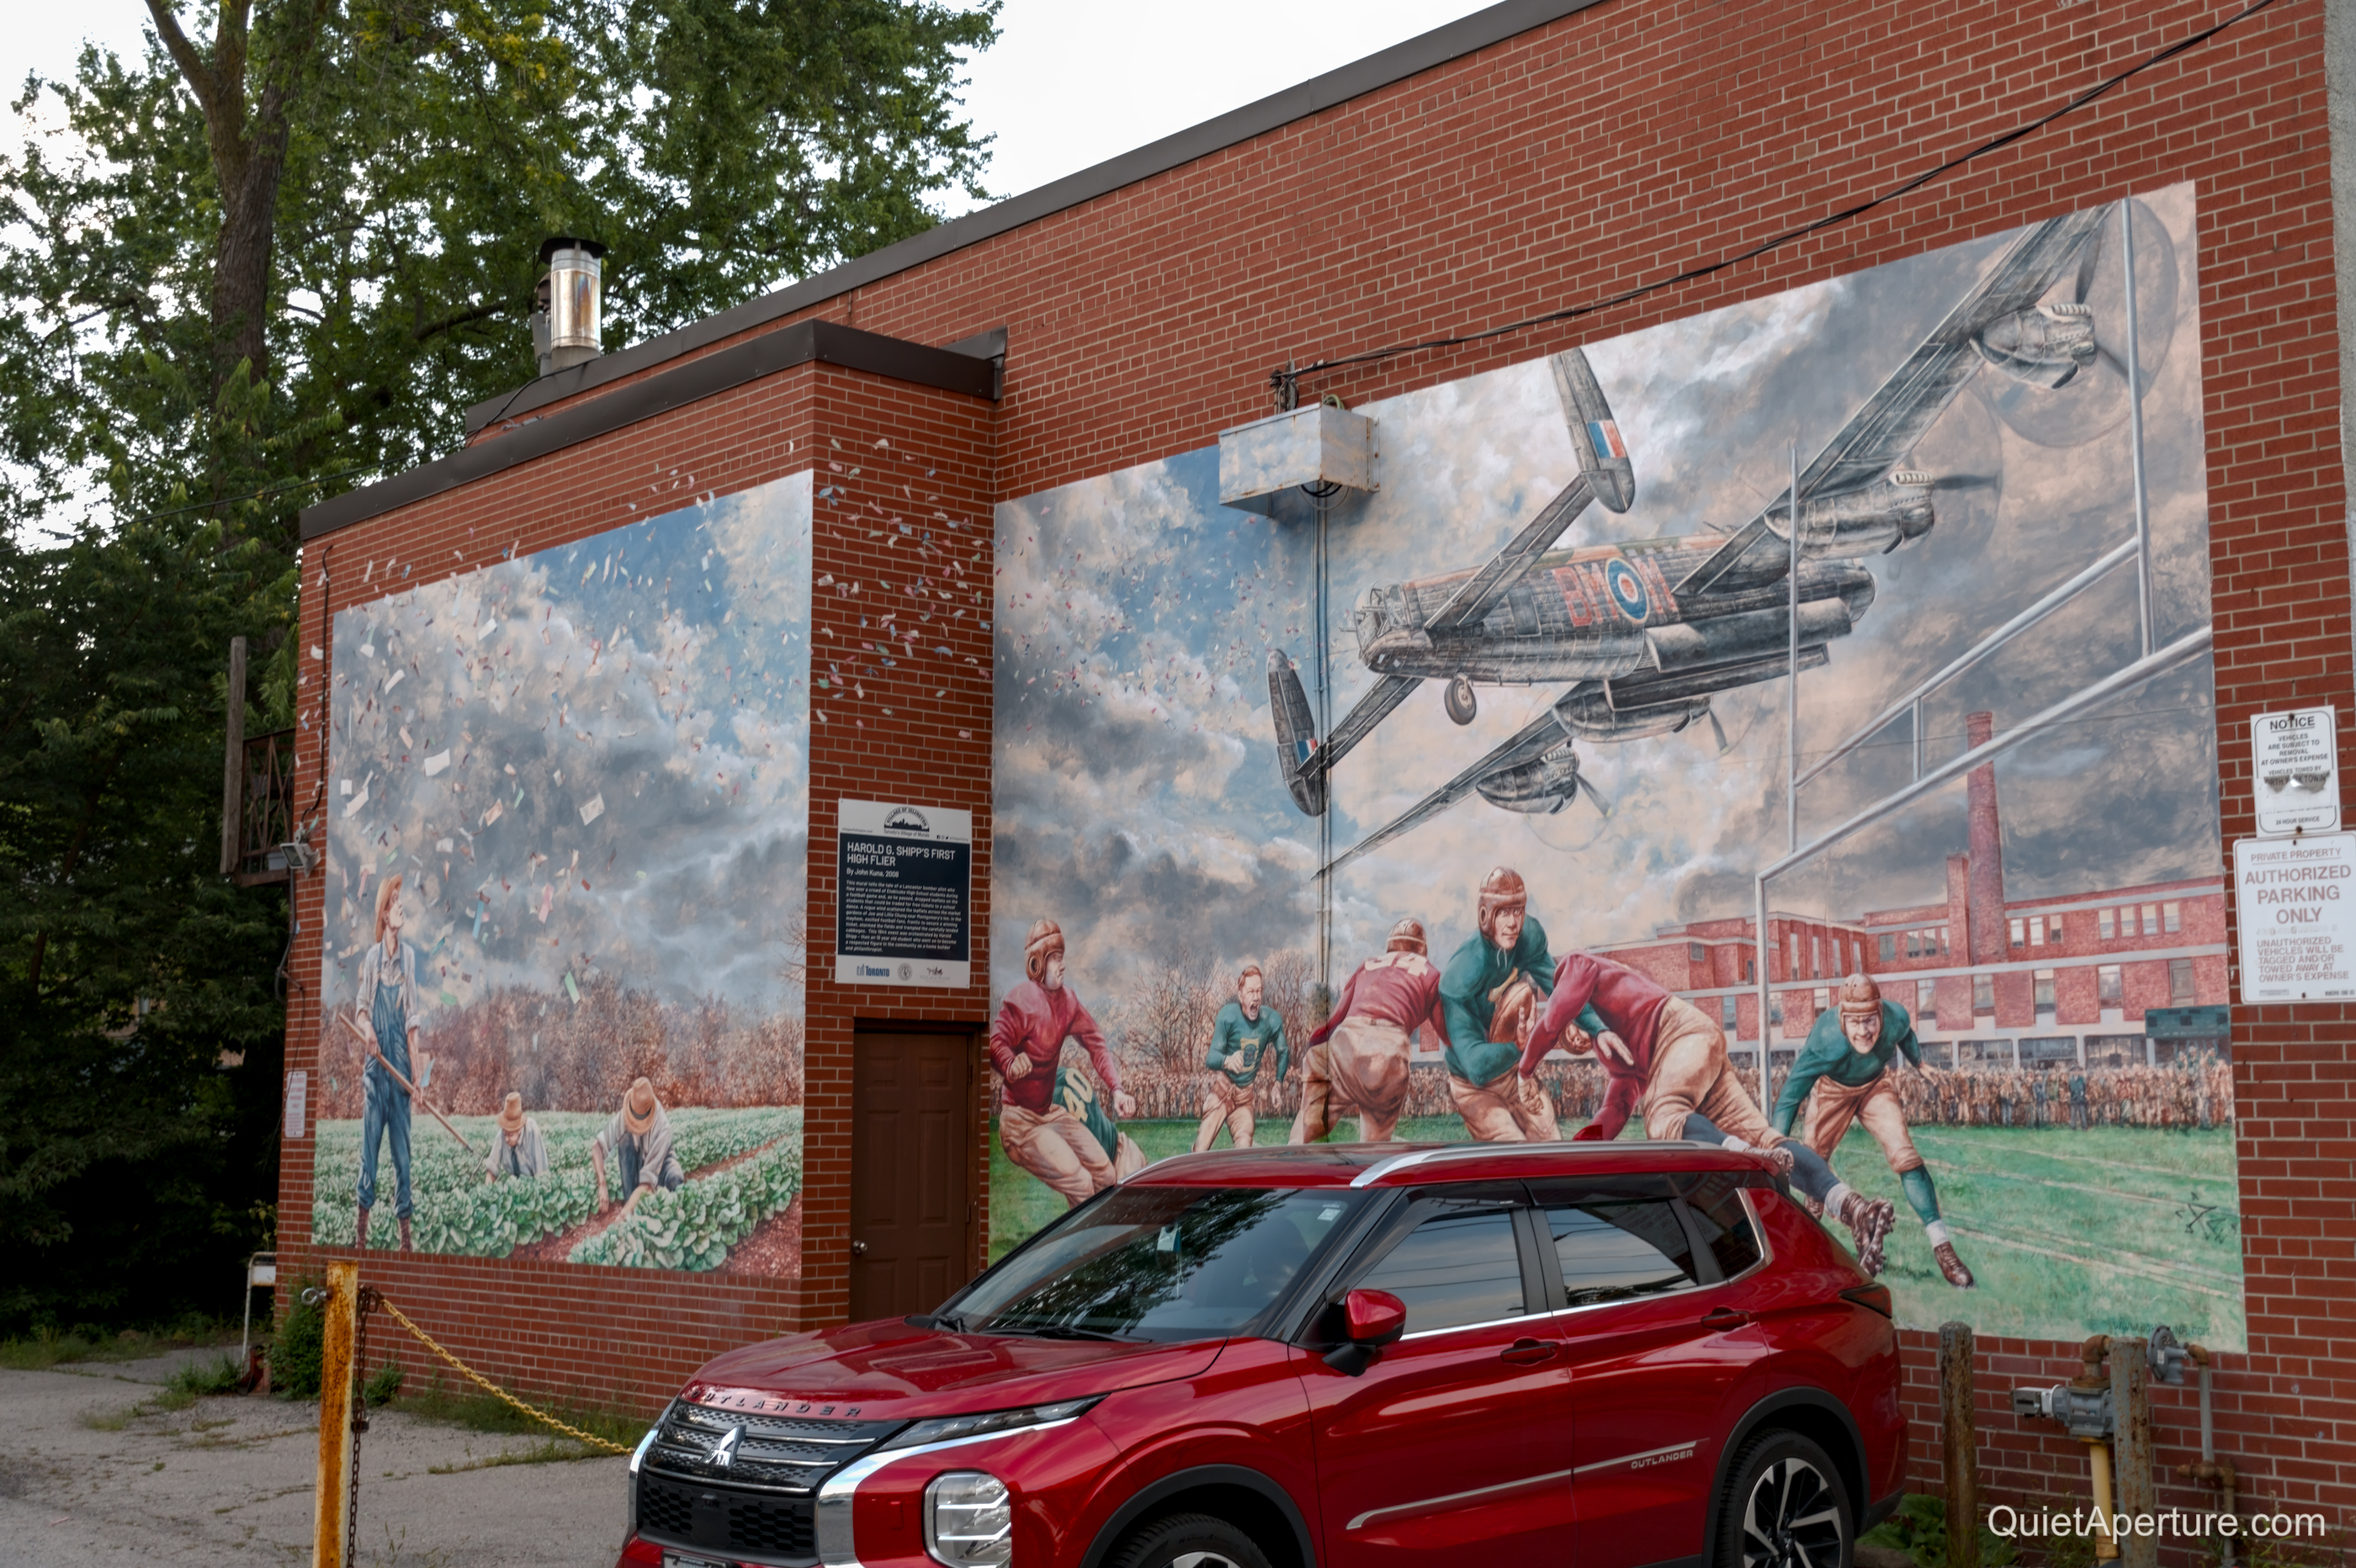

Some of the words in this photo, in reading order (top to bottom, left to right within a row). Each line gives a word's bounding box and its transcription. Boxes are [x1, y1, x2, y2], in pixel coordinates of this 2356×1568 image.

[2270, 716, 2315, 729] NOTICE
[2279, 733, 2308, 741] VEHICLES
[2282, 740, 2310, 750] SUBJECT
[2279, 748, 2308, 756] REMOVAL
[2271, 755, 2298, 765] OWNER'S
[2299, 754, 2328, 762] EXPENSE
[847, 842, 884, 855] HAROLD
[886, 845, 894, 856] G.
[896, 845, 929, 858] SHIPP'S
[931, 849, 955, 860] FIRST
[2251, 851, 2288, 861] PRIVATE
[2290, 847, 2341, 859] PROPERTY
[846, 853, 868, 865] HIGH
[871, 856, 895, 866] FLIER
[846, 867, 854, 876] By
[2245, 865, 2351, 885] AUTHORIZED
[2258, 885, 2340, 904] PARKING
[2276, 907, 2322, 924] ONLY
[2257, 936, 2332, 948] UNAUTHORIZED
[2258, 946, 2304, 956] VEHICLES
[2306, 945, 2329, 954] WILL
[2331, 944, 2343, 952] BE
[2258, 956, 2295, 965] TAGGED
[2299, 954, 2334, 963] AND/OR
[866, 966, 889, 977] TORONTO
[2259, 964, 2293, 974] TOWED
[2295, 962, 2319, 972] AWAY
[2322, 961, 2333, 971] AT
[2259, 972, 2303, 983] OWNER'S
[2305, 971, 2349, 980] EXPENSE
[691, 1390, 863, 1418] OUTLANDER
[1631, 1449, 1693, 1469] OUTLANDER
